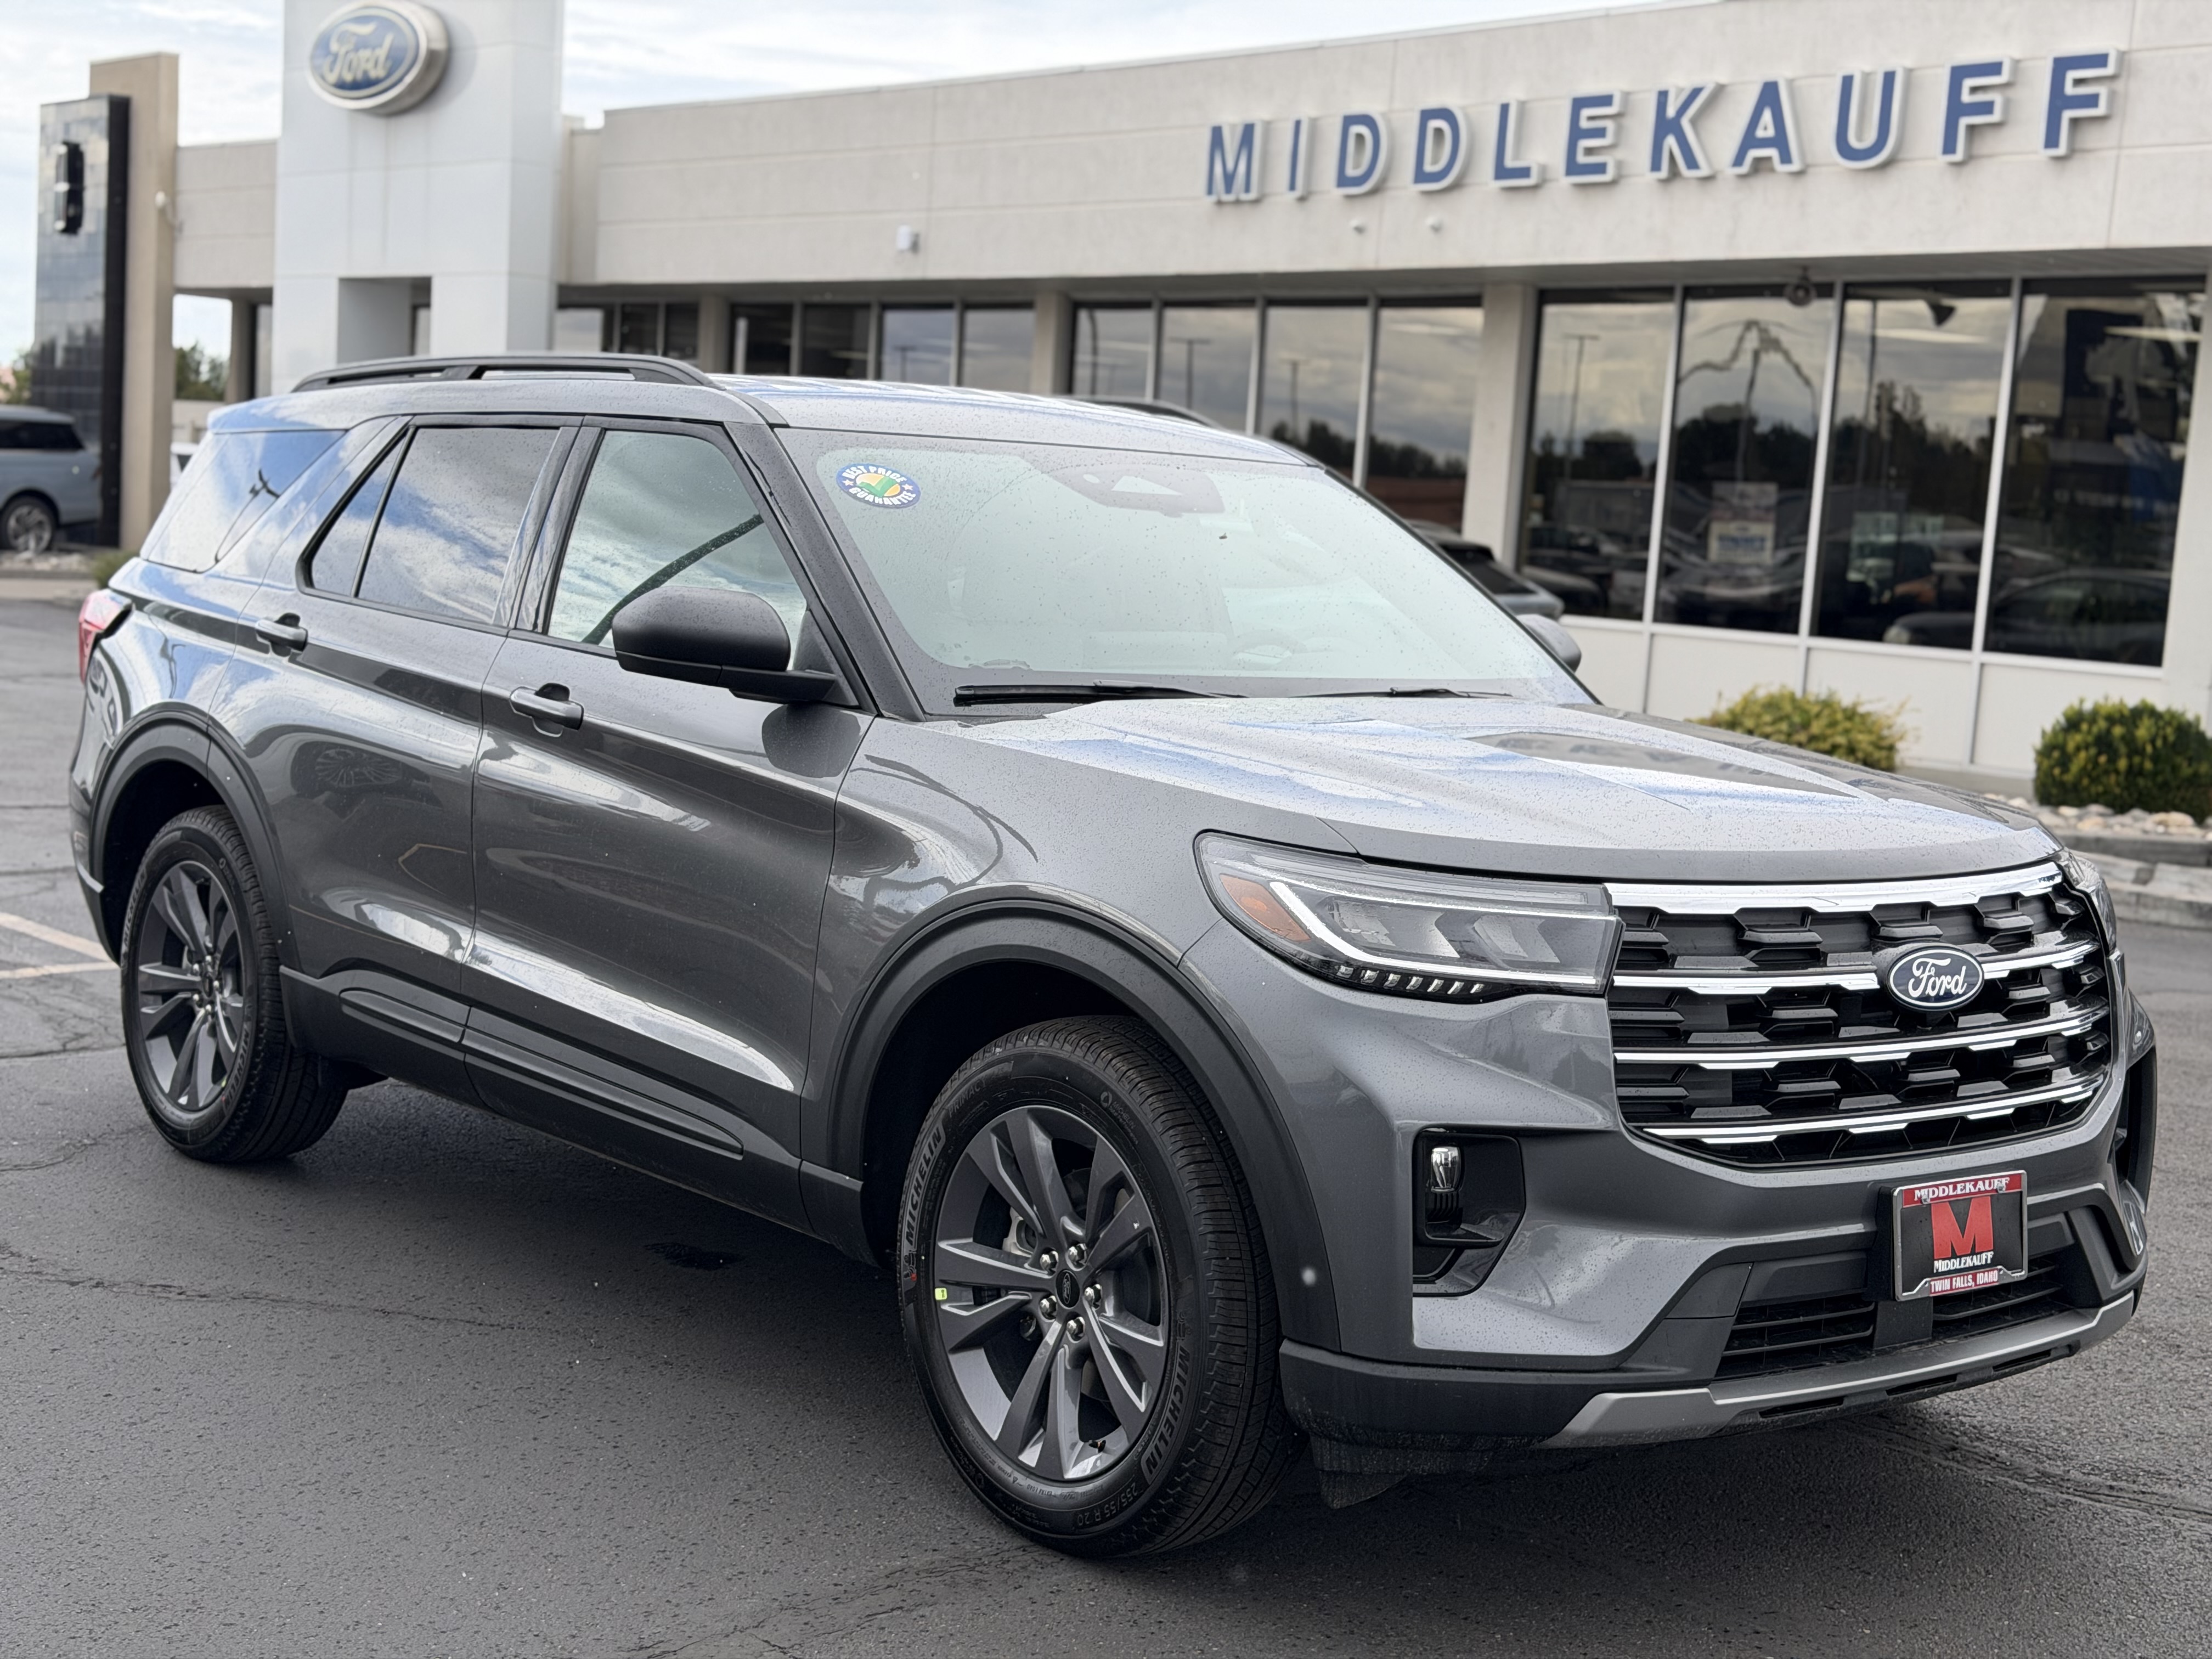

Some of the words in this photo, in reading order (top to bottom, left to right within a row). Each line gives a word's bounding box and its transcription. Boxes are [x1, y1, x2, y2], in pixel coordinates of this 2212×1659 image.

[323, 21, 394, 84] Ford
[1205, 48, 2119, 202] MIDDLEKAUFF
[842, 465, 868, 479] BEST
[868, 466, 907, 483] PRICE
[1908, 958, 1967, 998] Ford
[948, 1079, 987, 1118] PRIMACY
[905, 1125, 942, 1246] MICHELIN
[1914, 1177, 2010, 1200] MIDDLEKAUFF
[1931, 1196, 1994, 1260] M
[1933, 1251, 1994, 1273] MIDDLEKAUFF
[1931, 1279, 1950, 1293] TWIN
[1952, 1274, 1974, 1288] FALLS,
[1977, 1270, 1998, 1285] IDAHO
[1144, 1346, 1190, 1474] MICHELIN
[1094, 1508, 1102, 1521] R
[1104, 1482, 1138, 1517] 255/55
[1077, 1513, 1090, 1526] 20
